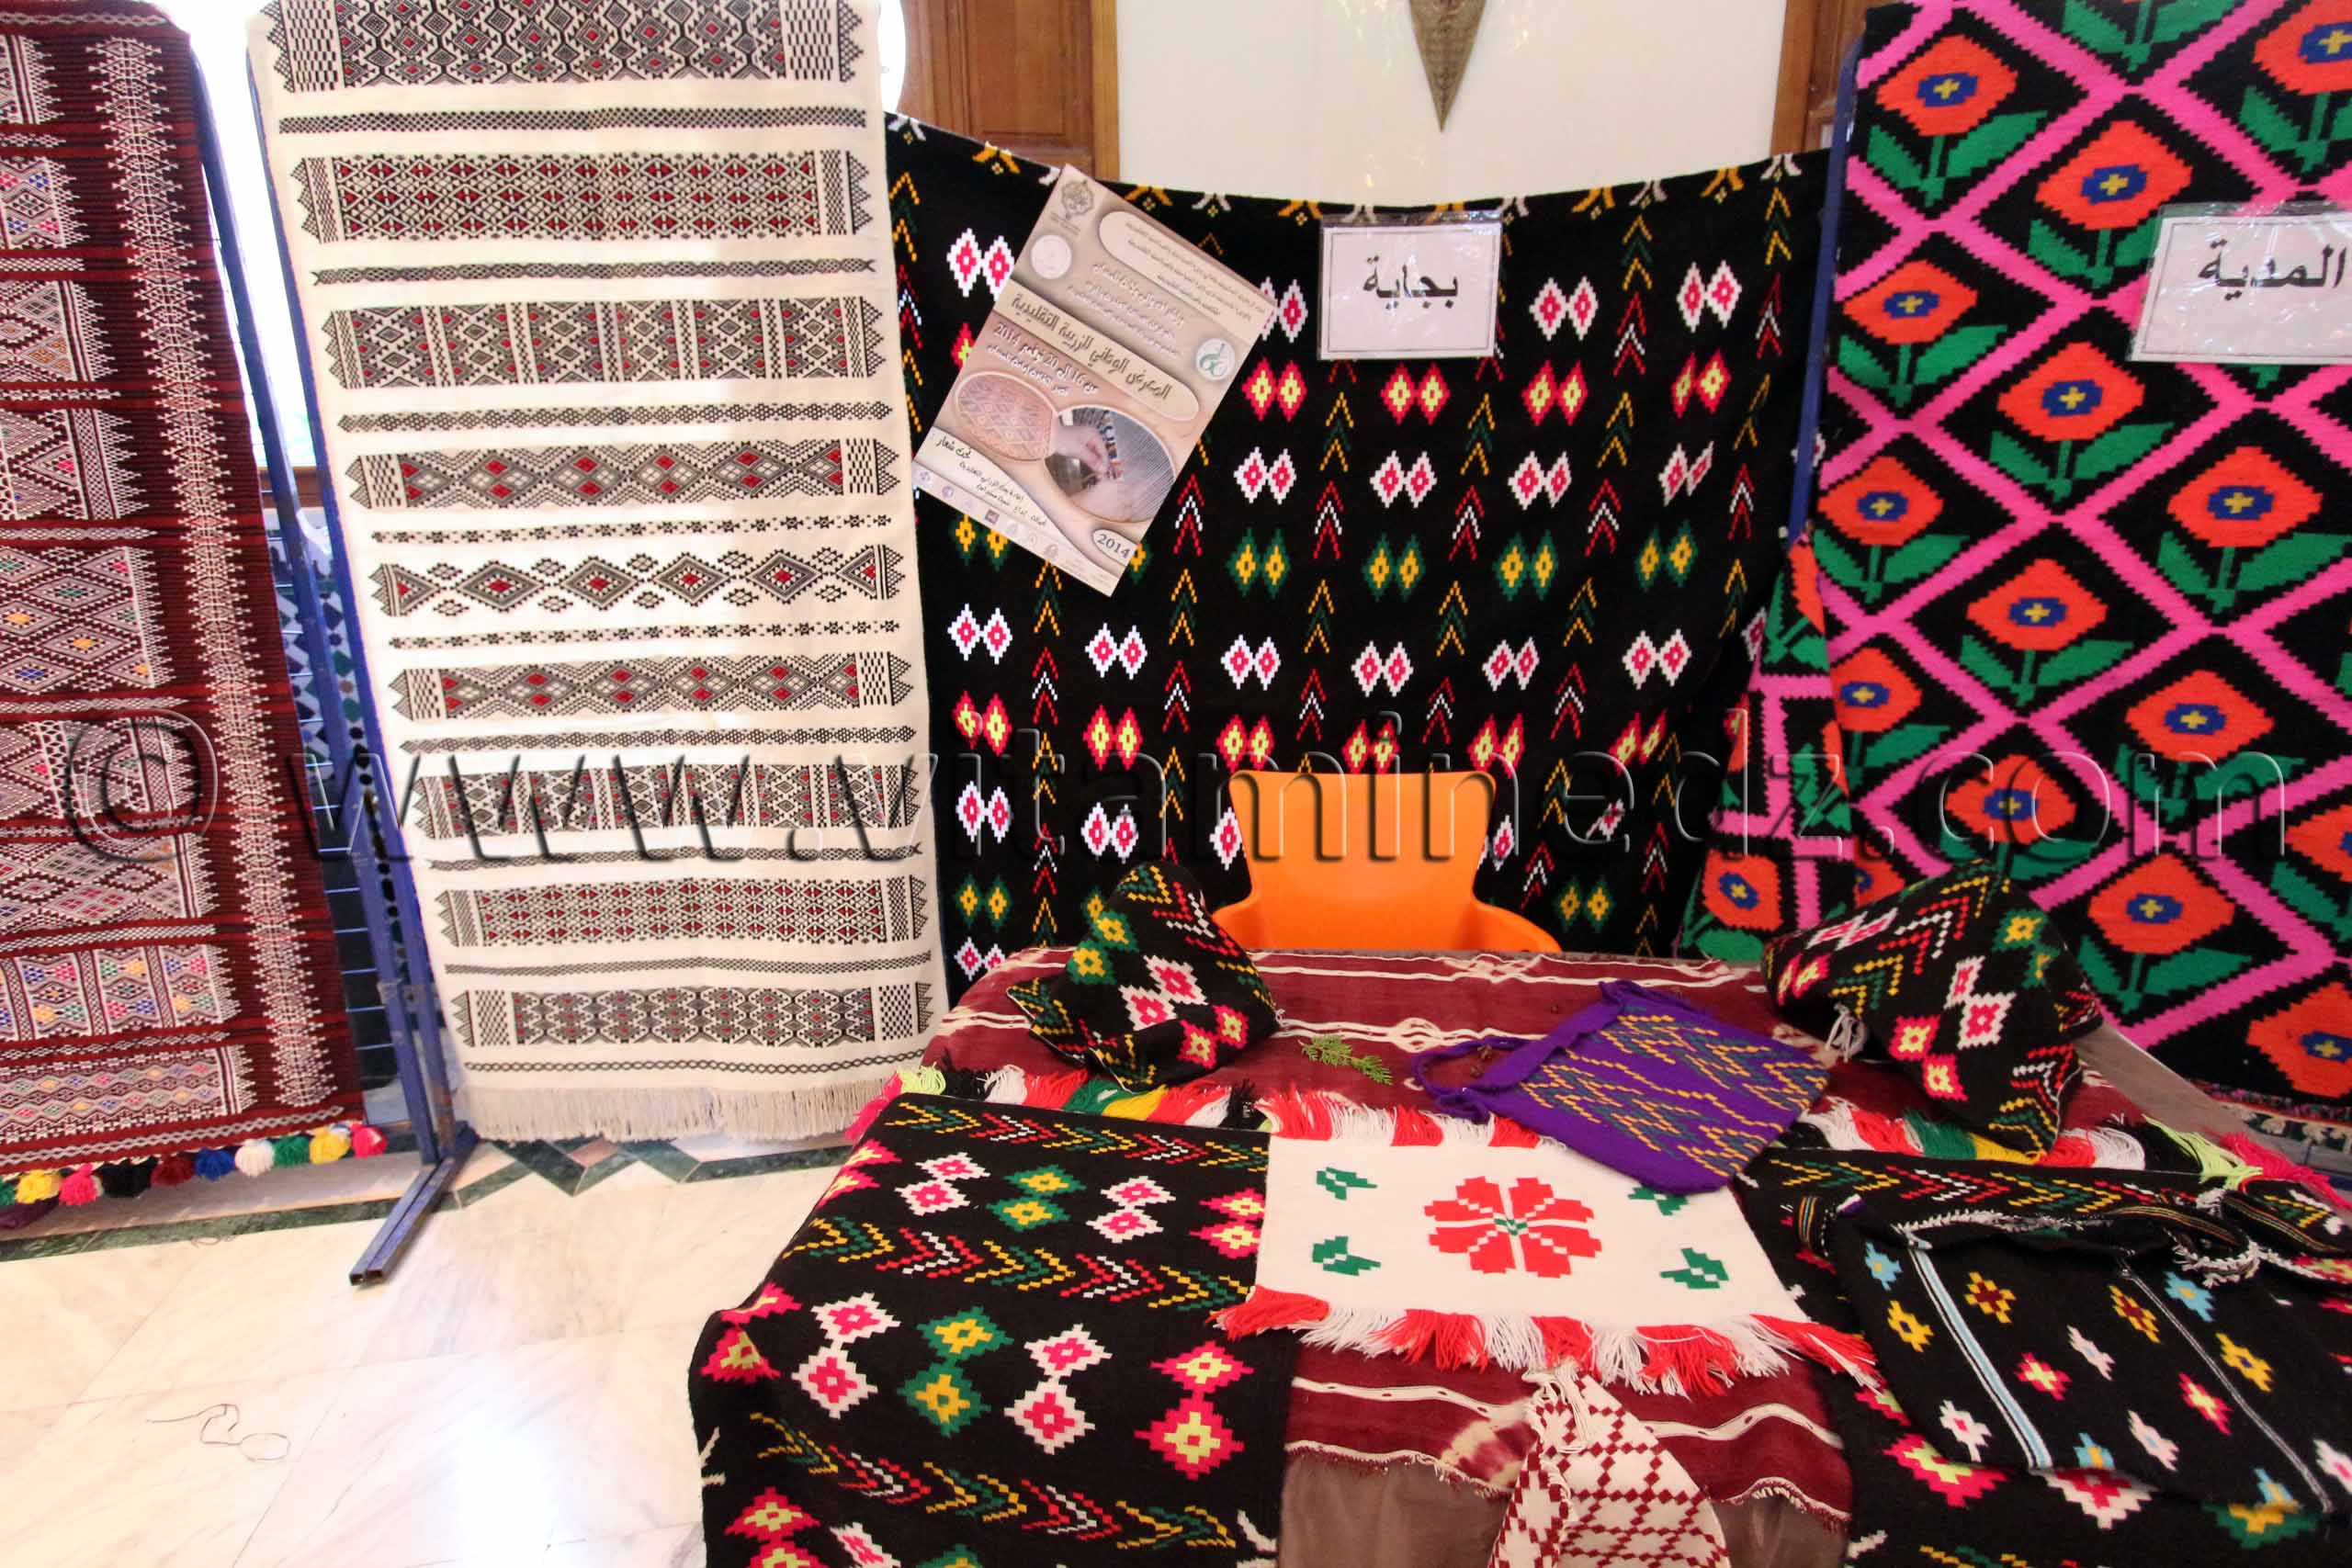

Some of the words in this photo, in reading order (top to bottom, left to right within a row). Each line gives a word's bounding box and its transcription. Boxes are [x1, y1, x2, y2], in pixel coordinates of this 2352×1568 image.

[1363, 255, 1458, 310] بجاية
[2198, 239, 2347, 301] المدية
[1012, 293, 1060, 332] التقليدية
[993, 321, 1022, 346] 2014
[1044, 353, 1059, 369] 20
[1088, 345, 1129, 373] الوطني
[1071, 369, 1086, 386] 16
[1125, 368, 1172, 400] المعرض
[936, 435, 956, 453] شعار
[1097, 533, 1131, 558] 2014
